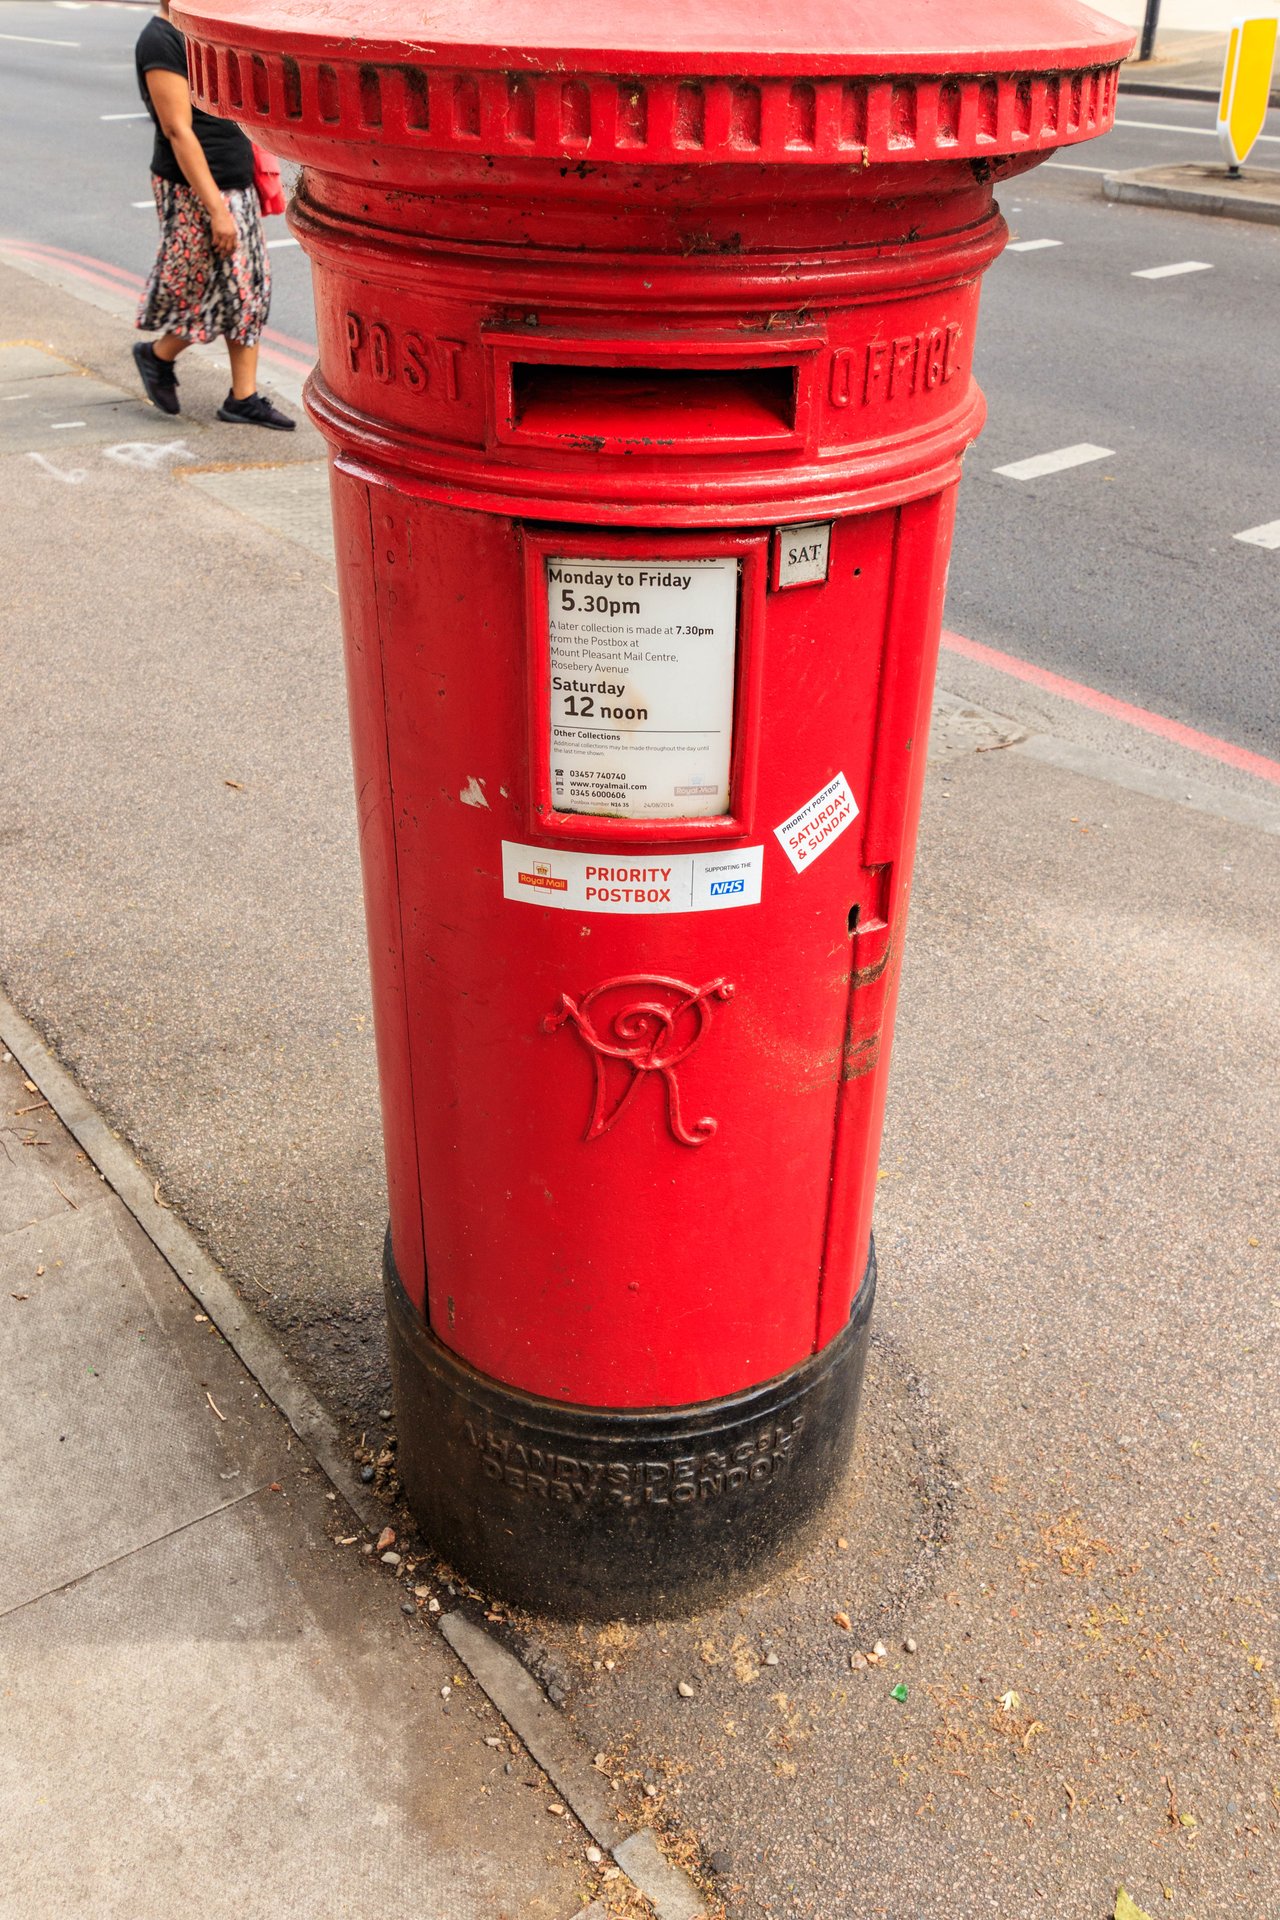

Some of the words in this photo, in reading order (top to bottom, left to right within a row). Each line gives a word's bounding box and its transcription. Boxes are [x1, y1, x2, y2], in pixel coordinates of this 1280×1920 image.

[346, 310, 467, 402] POST
[828, 322, 962, 408] OFFICE
[788, 544, 821, 565] SAT
[549, 569, 613, 588] Monday
[618, 573, 634, 586] to
[639, 573, 691, 589] Friday
[561, 589, 640, 617] 5.30pm
[558, 622, 579, 631] later
[581, 624, 624, 633] collection
[627, 625, 634, 634] is
[636, 626, 662, 635] made
[664, 627, 673, 635] at
[676, 626, 714, 636] 7.30pm
[550, 635, 571, 644] from
[574, 636, 589, 645] the
[592, 637, 628, 647] Postbox
[630, 639, 639, 647] at
[551, 648, 580, 658] Mount
[582, 650, 621, 661] Pleasant
[624, 651, 643, 661] Mail
[645, 653, 679, 663] Centre,
[552, 660, 593, 673] Rosebery
[595, 664, 629, 673] Avenue
[553, 677, 625, 697] Saturday
[564, 696, 594, 717] 12
[601, 706, 648, 720] noon
[554, 729, 576, 738] Other
[578, 731, 620, 740] Collections
[570, 770, 594, 778] 03457
[596, 772, 626, 780] 740740
[570, 781, 647, 790] www.royalmail.com
[782, 806, 811, 834] PRIORITY
[812, 780, 840, 808] POSTBOX
[789, 791, 846, 849] SATURDAY
[797, 848, 807, 859] &
[808, 803, 851, 850] SUNDAY
[586, 866, 672, 882] PRIORITY
[705, 864, 740, 873] SUPPORTING
[520, 874, 544, 887] Royal
[545, 878, 566, 889] Mail
[712, 880, 743, 895] NHS
[586, 887, 671, 903] POSTBOX
[481, 1454, 598, 1504] DERBY
[644, 1447, 796, 1504] LONDON
